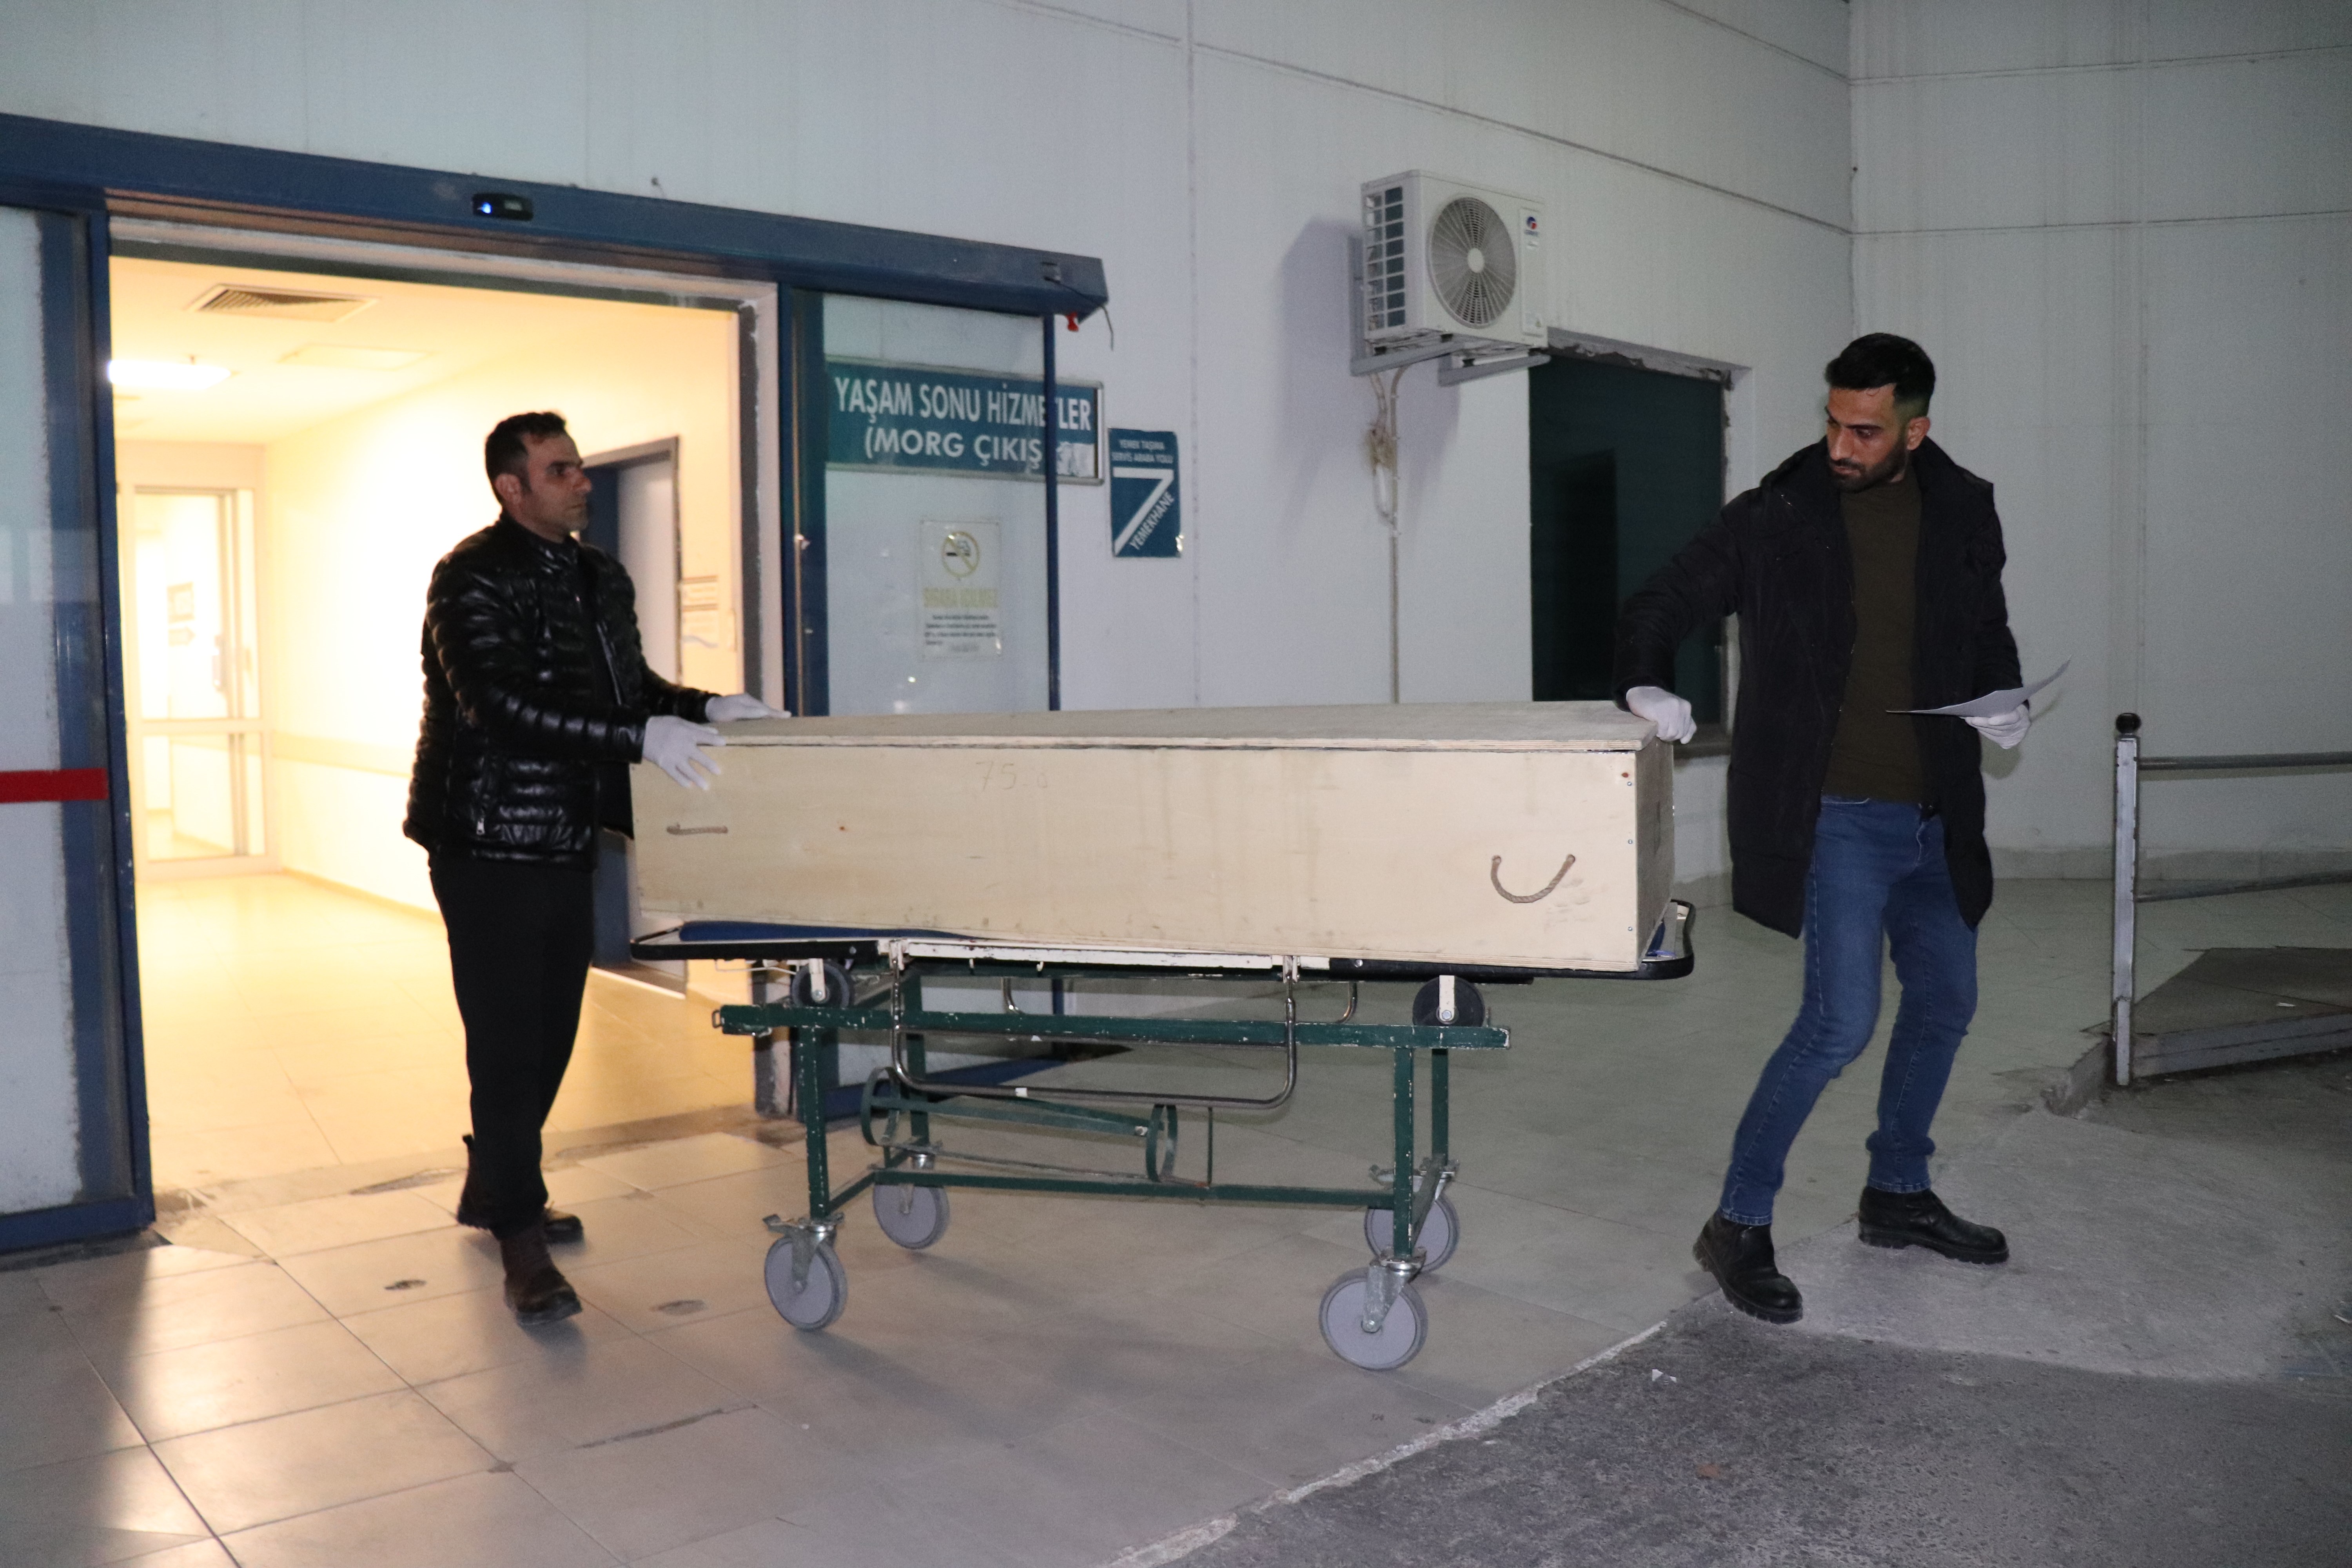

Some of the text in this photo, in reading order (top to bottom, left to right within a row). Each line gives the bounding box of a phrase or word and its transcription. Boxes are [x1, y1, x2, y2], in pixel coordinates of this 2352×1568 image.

[835, 377, 1091, 431] YAŞAM SONU HİZMELER
[865, 426, 964, 459] (MORG
[1130, 492, 1174, 550] YEMEKHANE
